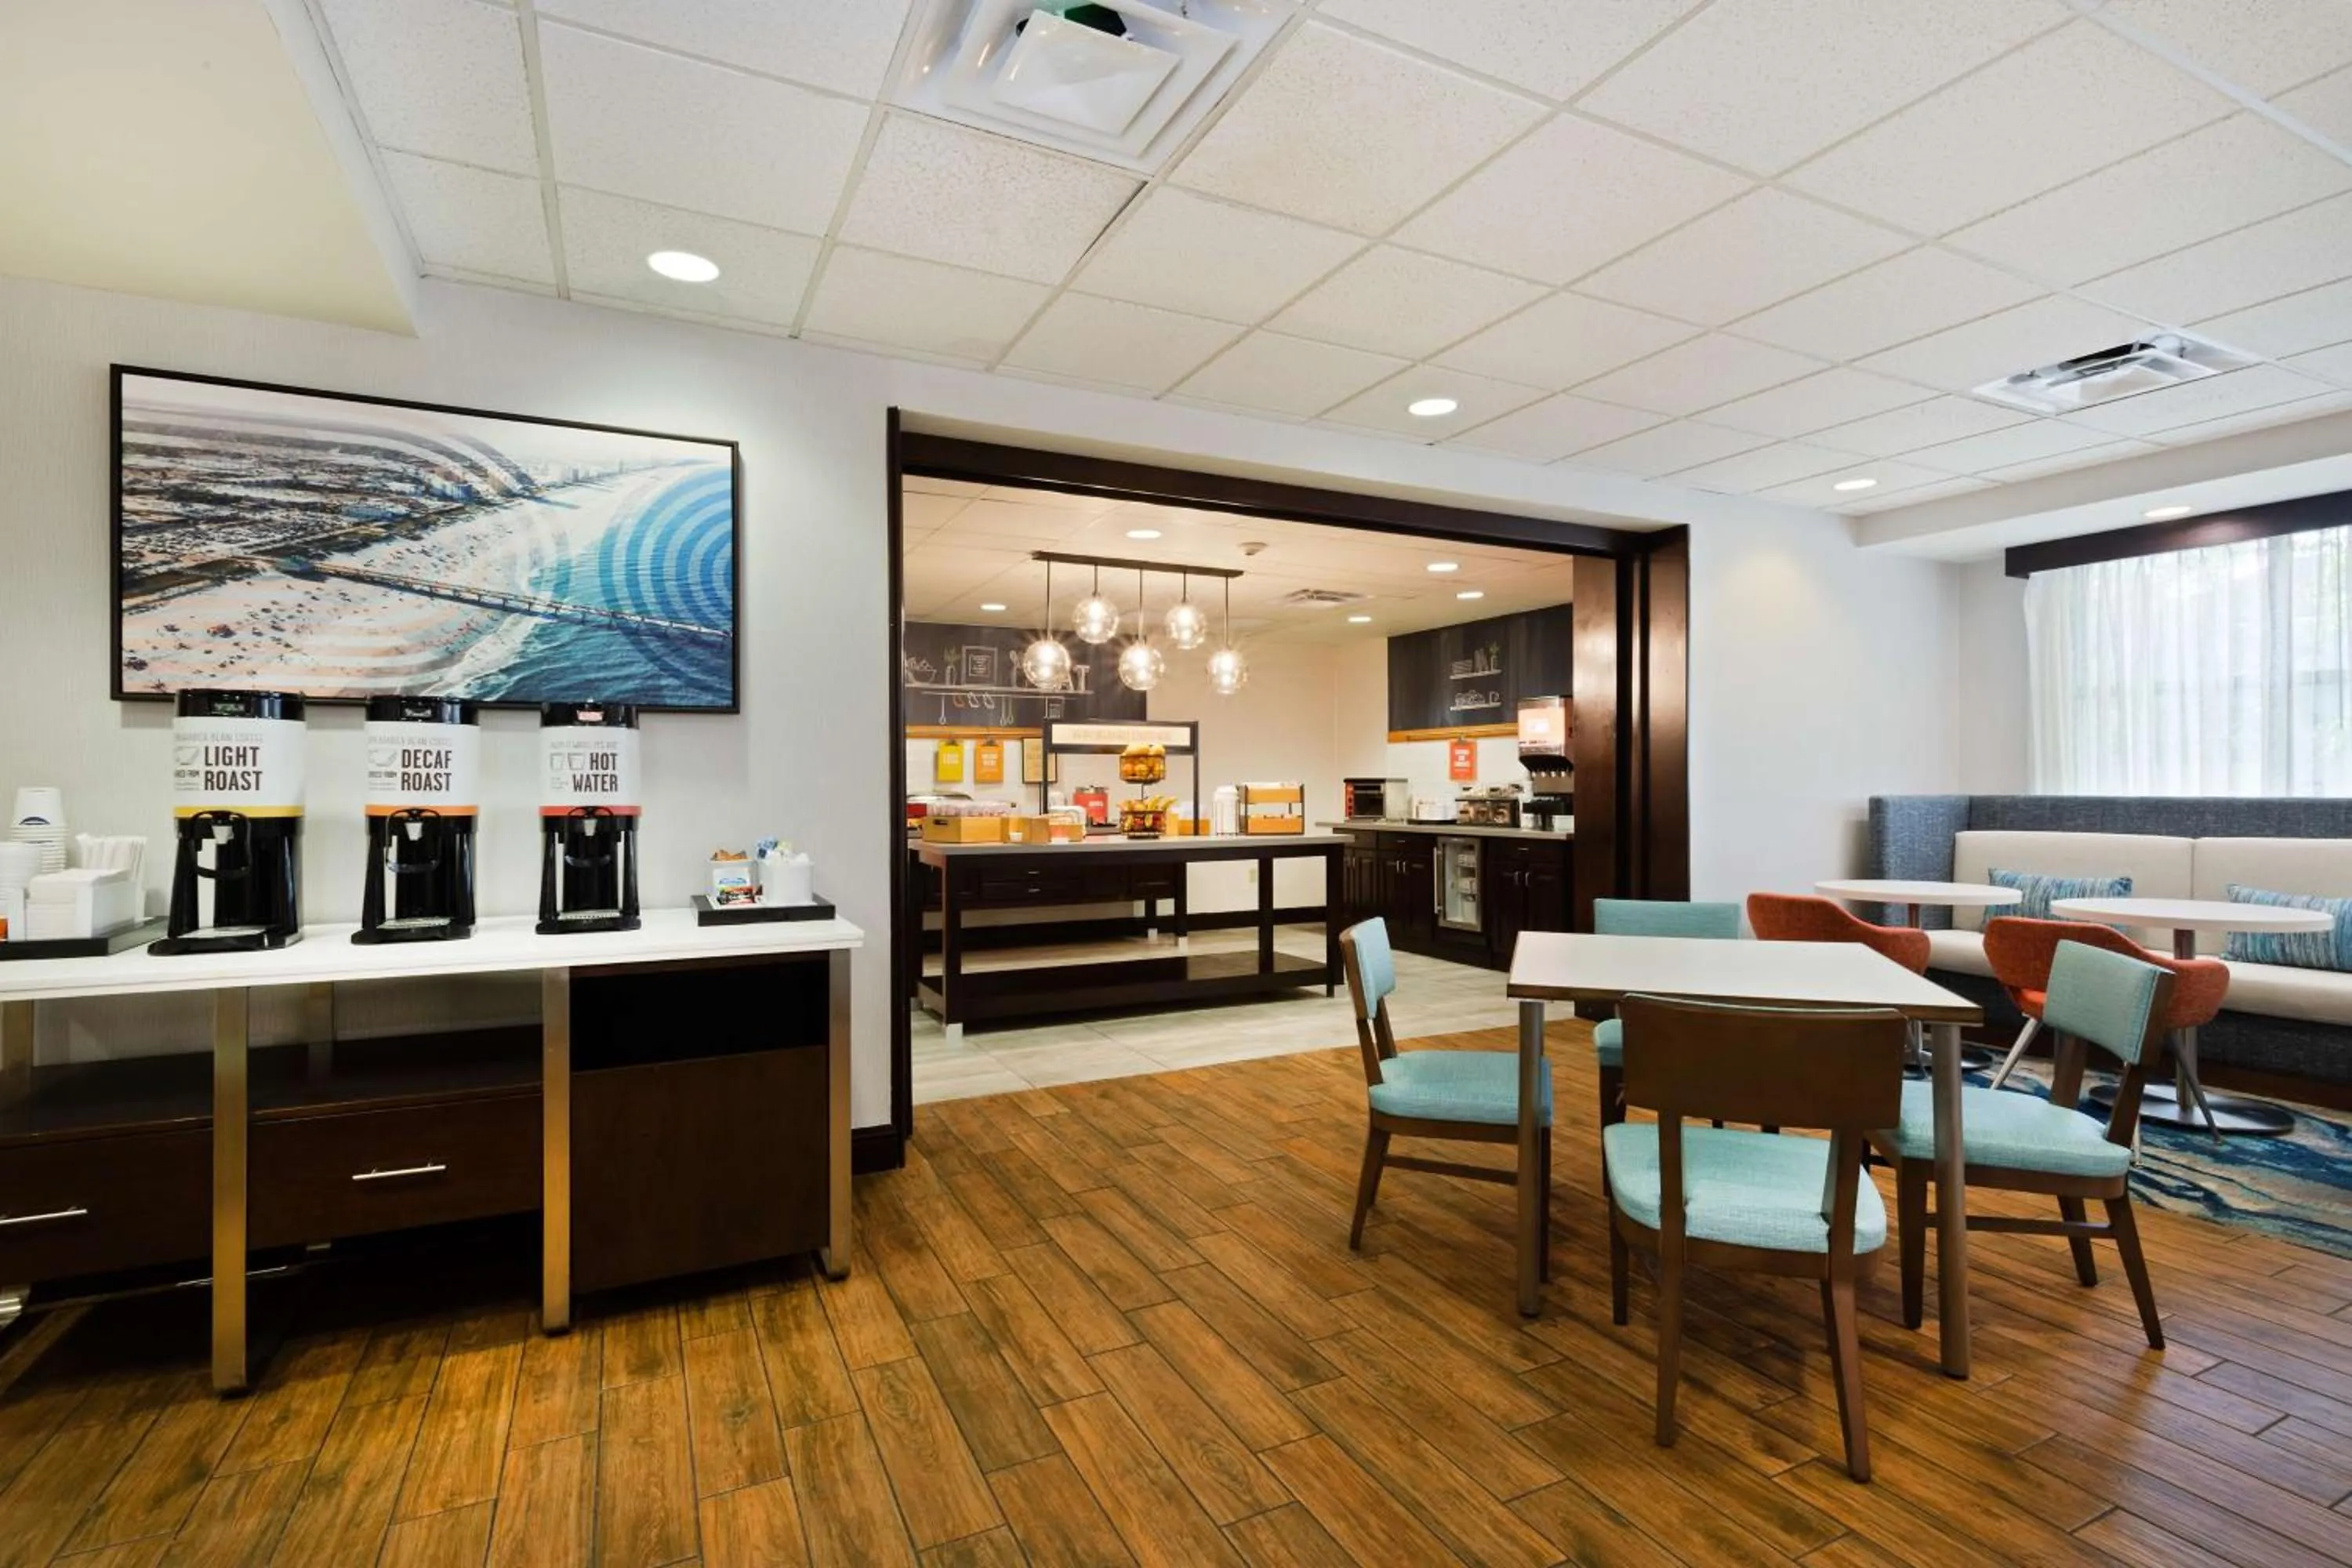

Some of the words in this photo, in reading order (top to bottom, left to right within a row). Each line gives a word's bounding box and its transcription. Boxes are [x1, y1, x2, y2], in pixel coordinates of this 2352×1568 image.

[205, 746, 260, 767] LIGHT
[401, 749, 452, 769] DECAF
[590, 752, 618, 771] HOT
[204, 771, 263, 791] ROAST
[401, 771, 452, 791] ROAST
[572, 773, 618, 792] WATER
